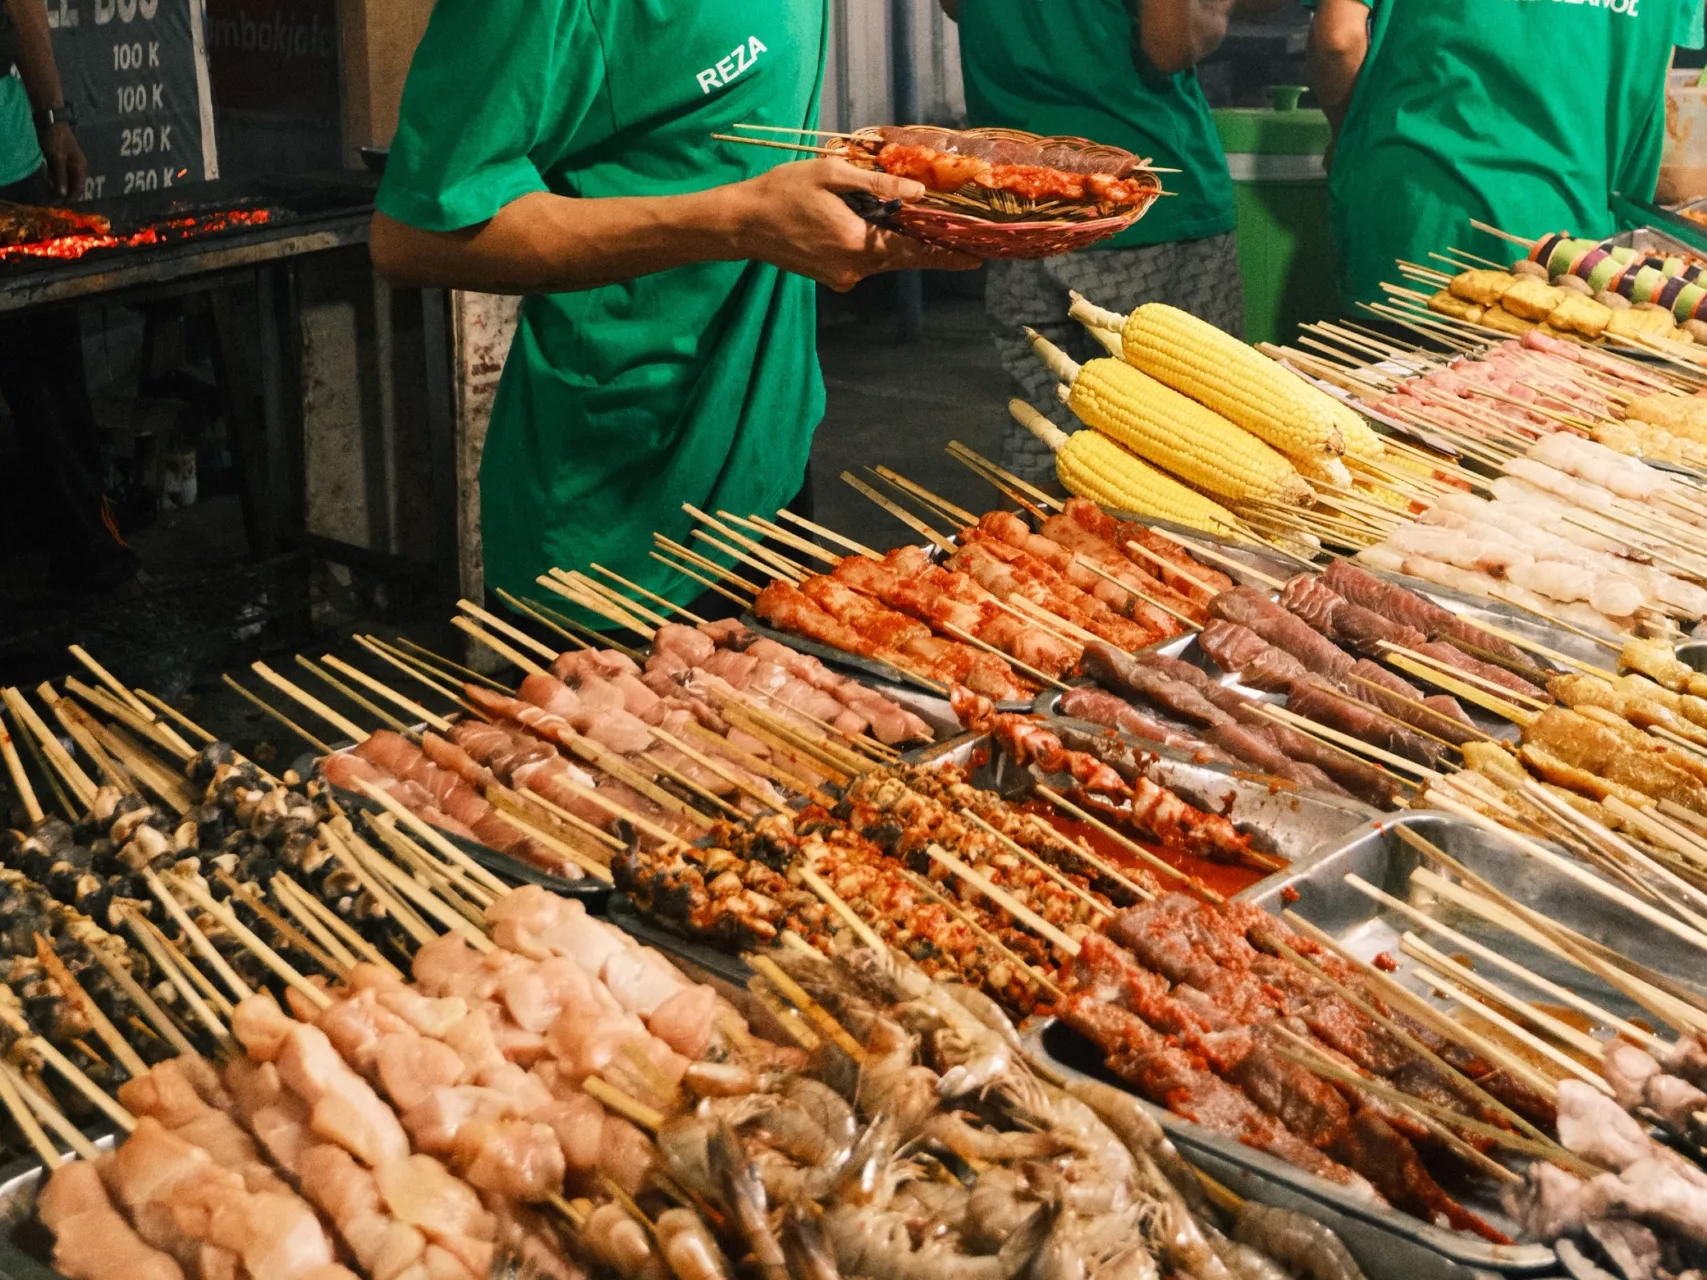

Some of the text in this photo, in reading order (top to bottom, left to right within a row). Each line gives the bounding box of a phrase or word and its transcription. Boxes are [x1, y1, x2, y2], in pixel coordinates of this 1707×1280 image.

[113, 41, 159, 70] 100 K
[696, 36, 768, 94] REZA
[117, 82, 163, 114] 100 K
[120, 125, 171, 157] 250 K
[163, 167, 175, 189] K
